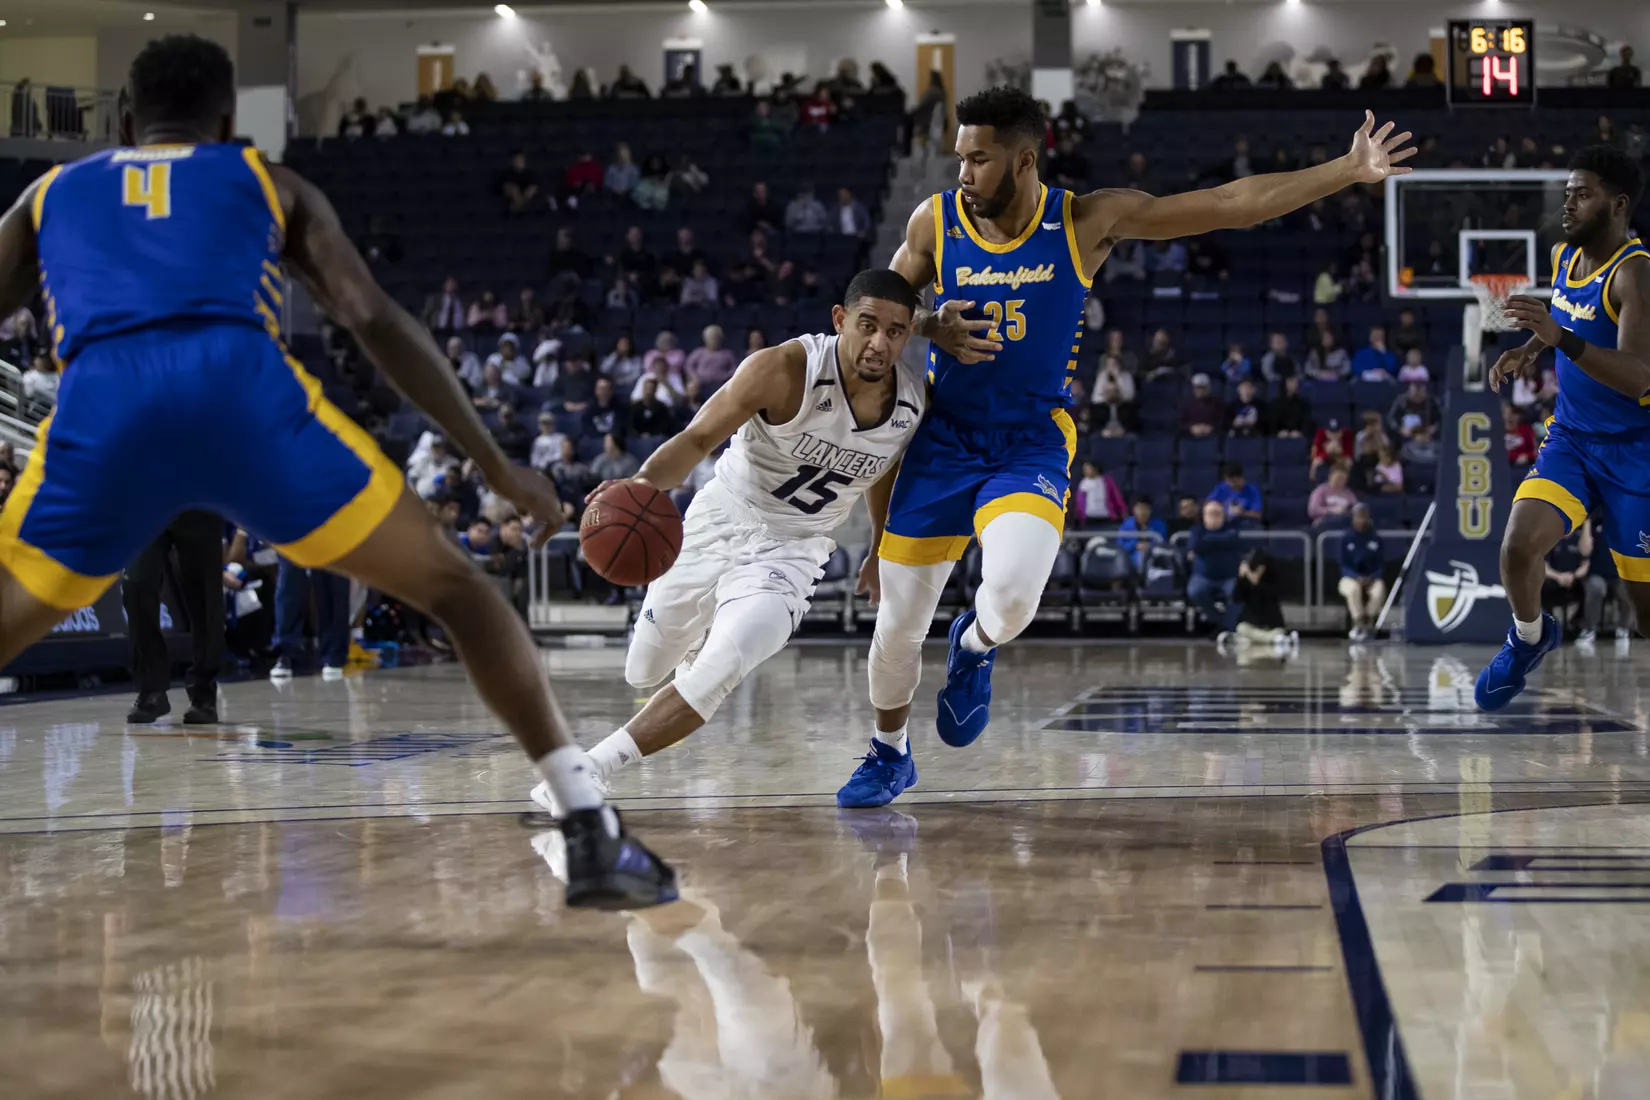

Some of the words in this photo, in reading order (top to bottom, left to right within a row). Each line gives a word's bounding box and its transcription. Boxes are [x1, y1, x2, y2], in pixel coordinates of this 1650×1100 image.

[1471, 27, 1526, 53] 6:16
[1482, 56, 1518, 96] 14
[122, 162, 171, 220] 4
[956, 263, 1055, 290] Bakersfield
[983, 299, 1026, 341] 25
[891, 418, 910, 429] WAC
[792, 432, 888, 478] LANCERS
[1456, 411, 1493, 539] CBU
[770, 464, 855, 515] 15
